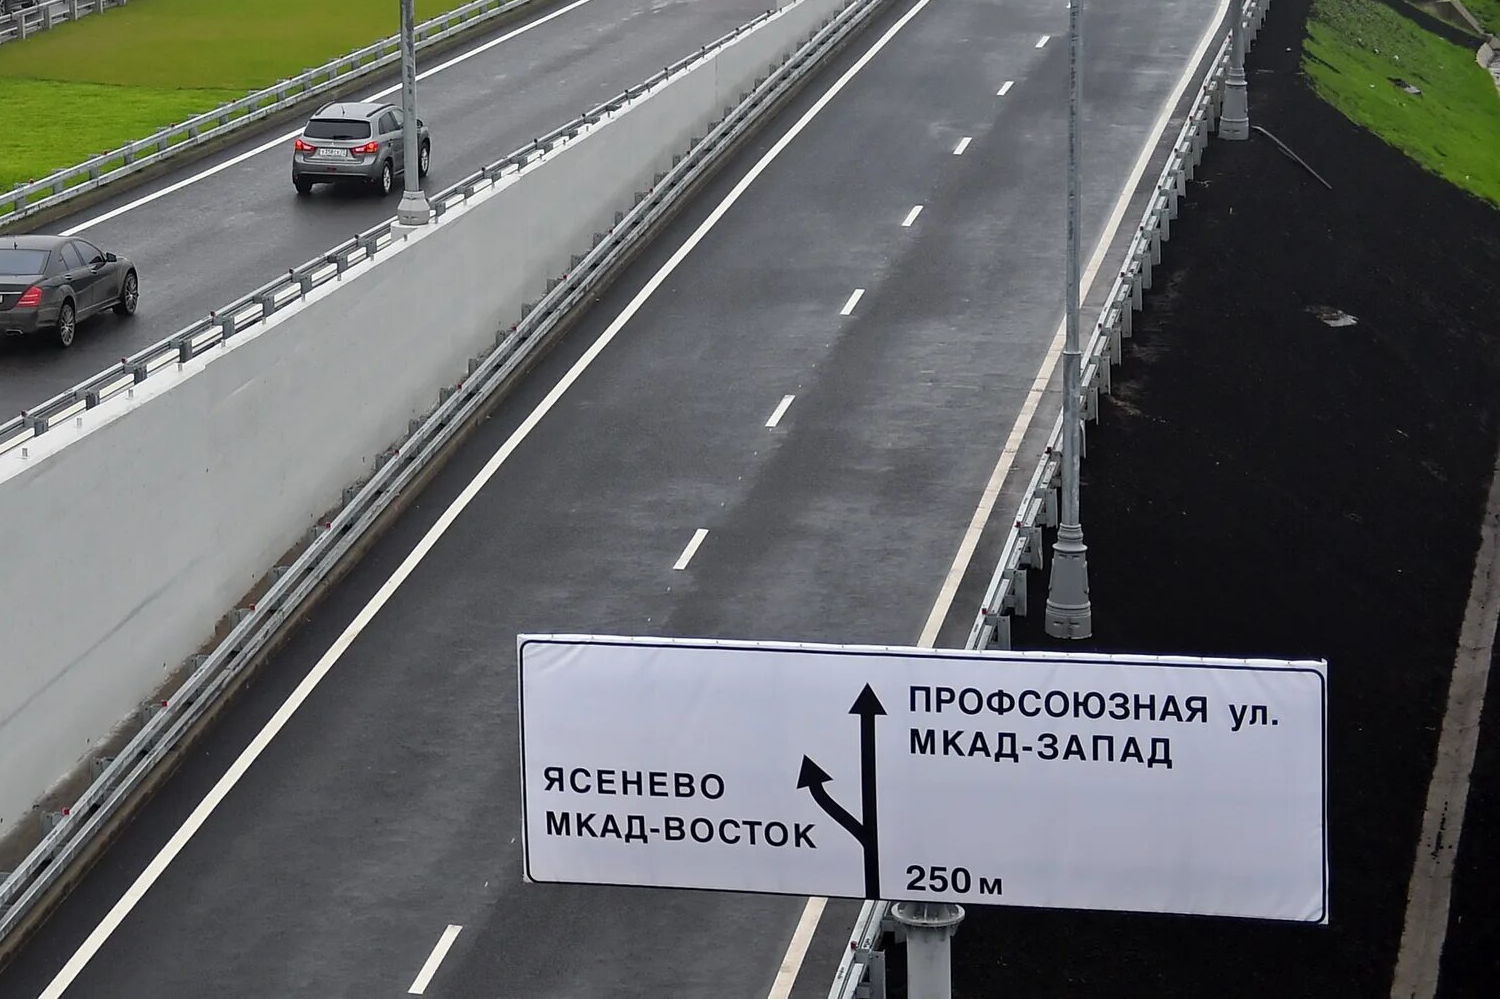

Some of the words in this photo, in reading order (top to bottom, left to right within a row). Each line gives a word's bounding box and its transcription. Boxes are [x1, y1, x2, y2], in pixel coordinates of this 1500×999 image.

[909, 685, 1208, 723] ПРОФСОЮЗНАЯ
[1228, 704, 1279, 732] ул.
[910, 728, 1173, 770] МКАД-ЗАПАД
[543, 766, 725, 800] ЯСЕНЕВО
[546, 810, 818, 849] МКАД-ВОСТОК
[906, 864, 972, 894] 250
[979, 877, 1003, 896] м
